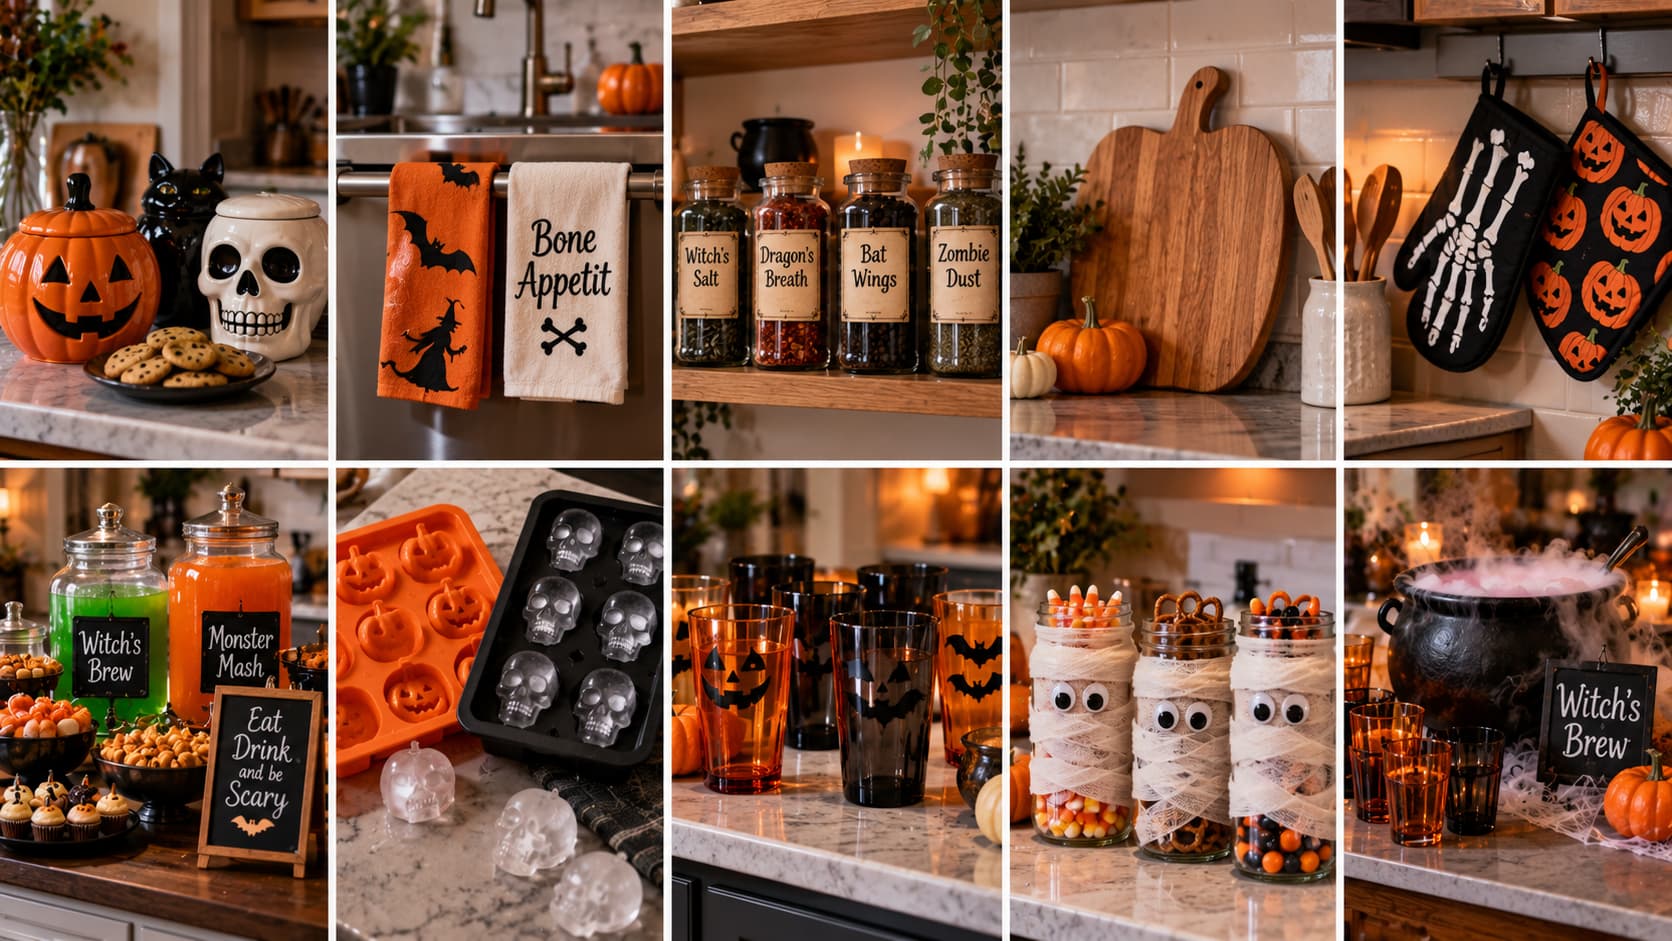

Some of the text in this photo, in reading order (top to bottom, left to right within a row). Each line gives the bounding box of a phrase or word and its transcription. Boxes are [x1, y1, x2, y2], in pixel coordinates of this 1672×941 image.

[531, 219, 597, 257] Bone
[685, 246, 729, 264] Witch's
[760, 246, 815, 268] Dragon's
[860, 244, 887, 263] Bat
[938, 242, 990, 262] Zombie
[514, 261, 612, 310] Appetit
[693, 269, 719, 287] Salt
[764, 269, 808, 287] Breath
[851, 268, 897, 293] Wings
[946, 268, 981, 288] Dust
[78, 630, 141, 655] Witch's
[208, 624, 274, 650] Monster
[87, 657, 134, 683] Brew
[215, 653, 265, 679] Mash
[1556, 683, 1641, 721] Witch's
[247, 706, 283, 733] Eat
[232, 733, 293, 763] Drink
[1562, 723, 1631, 759] Brew
[239, 764, 283, 782] and be
[225, 780, 289, 819] Scary
